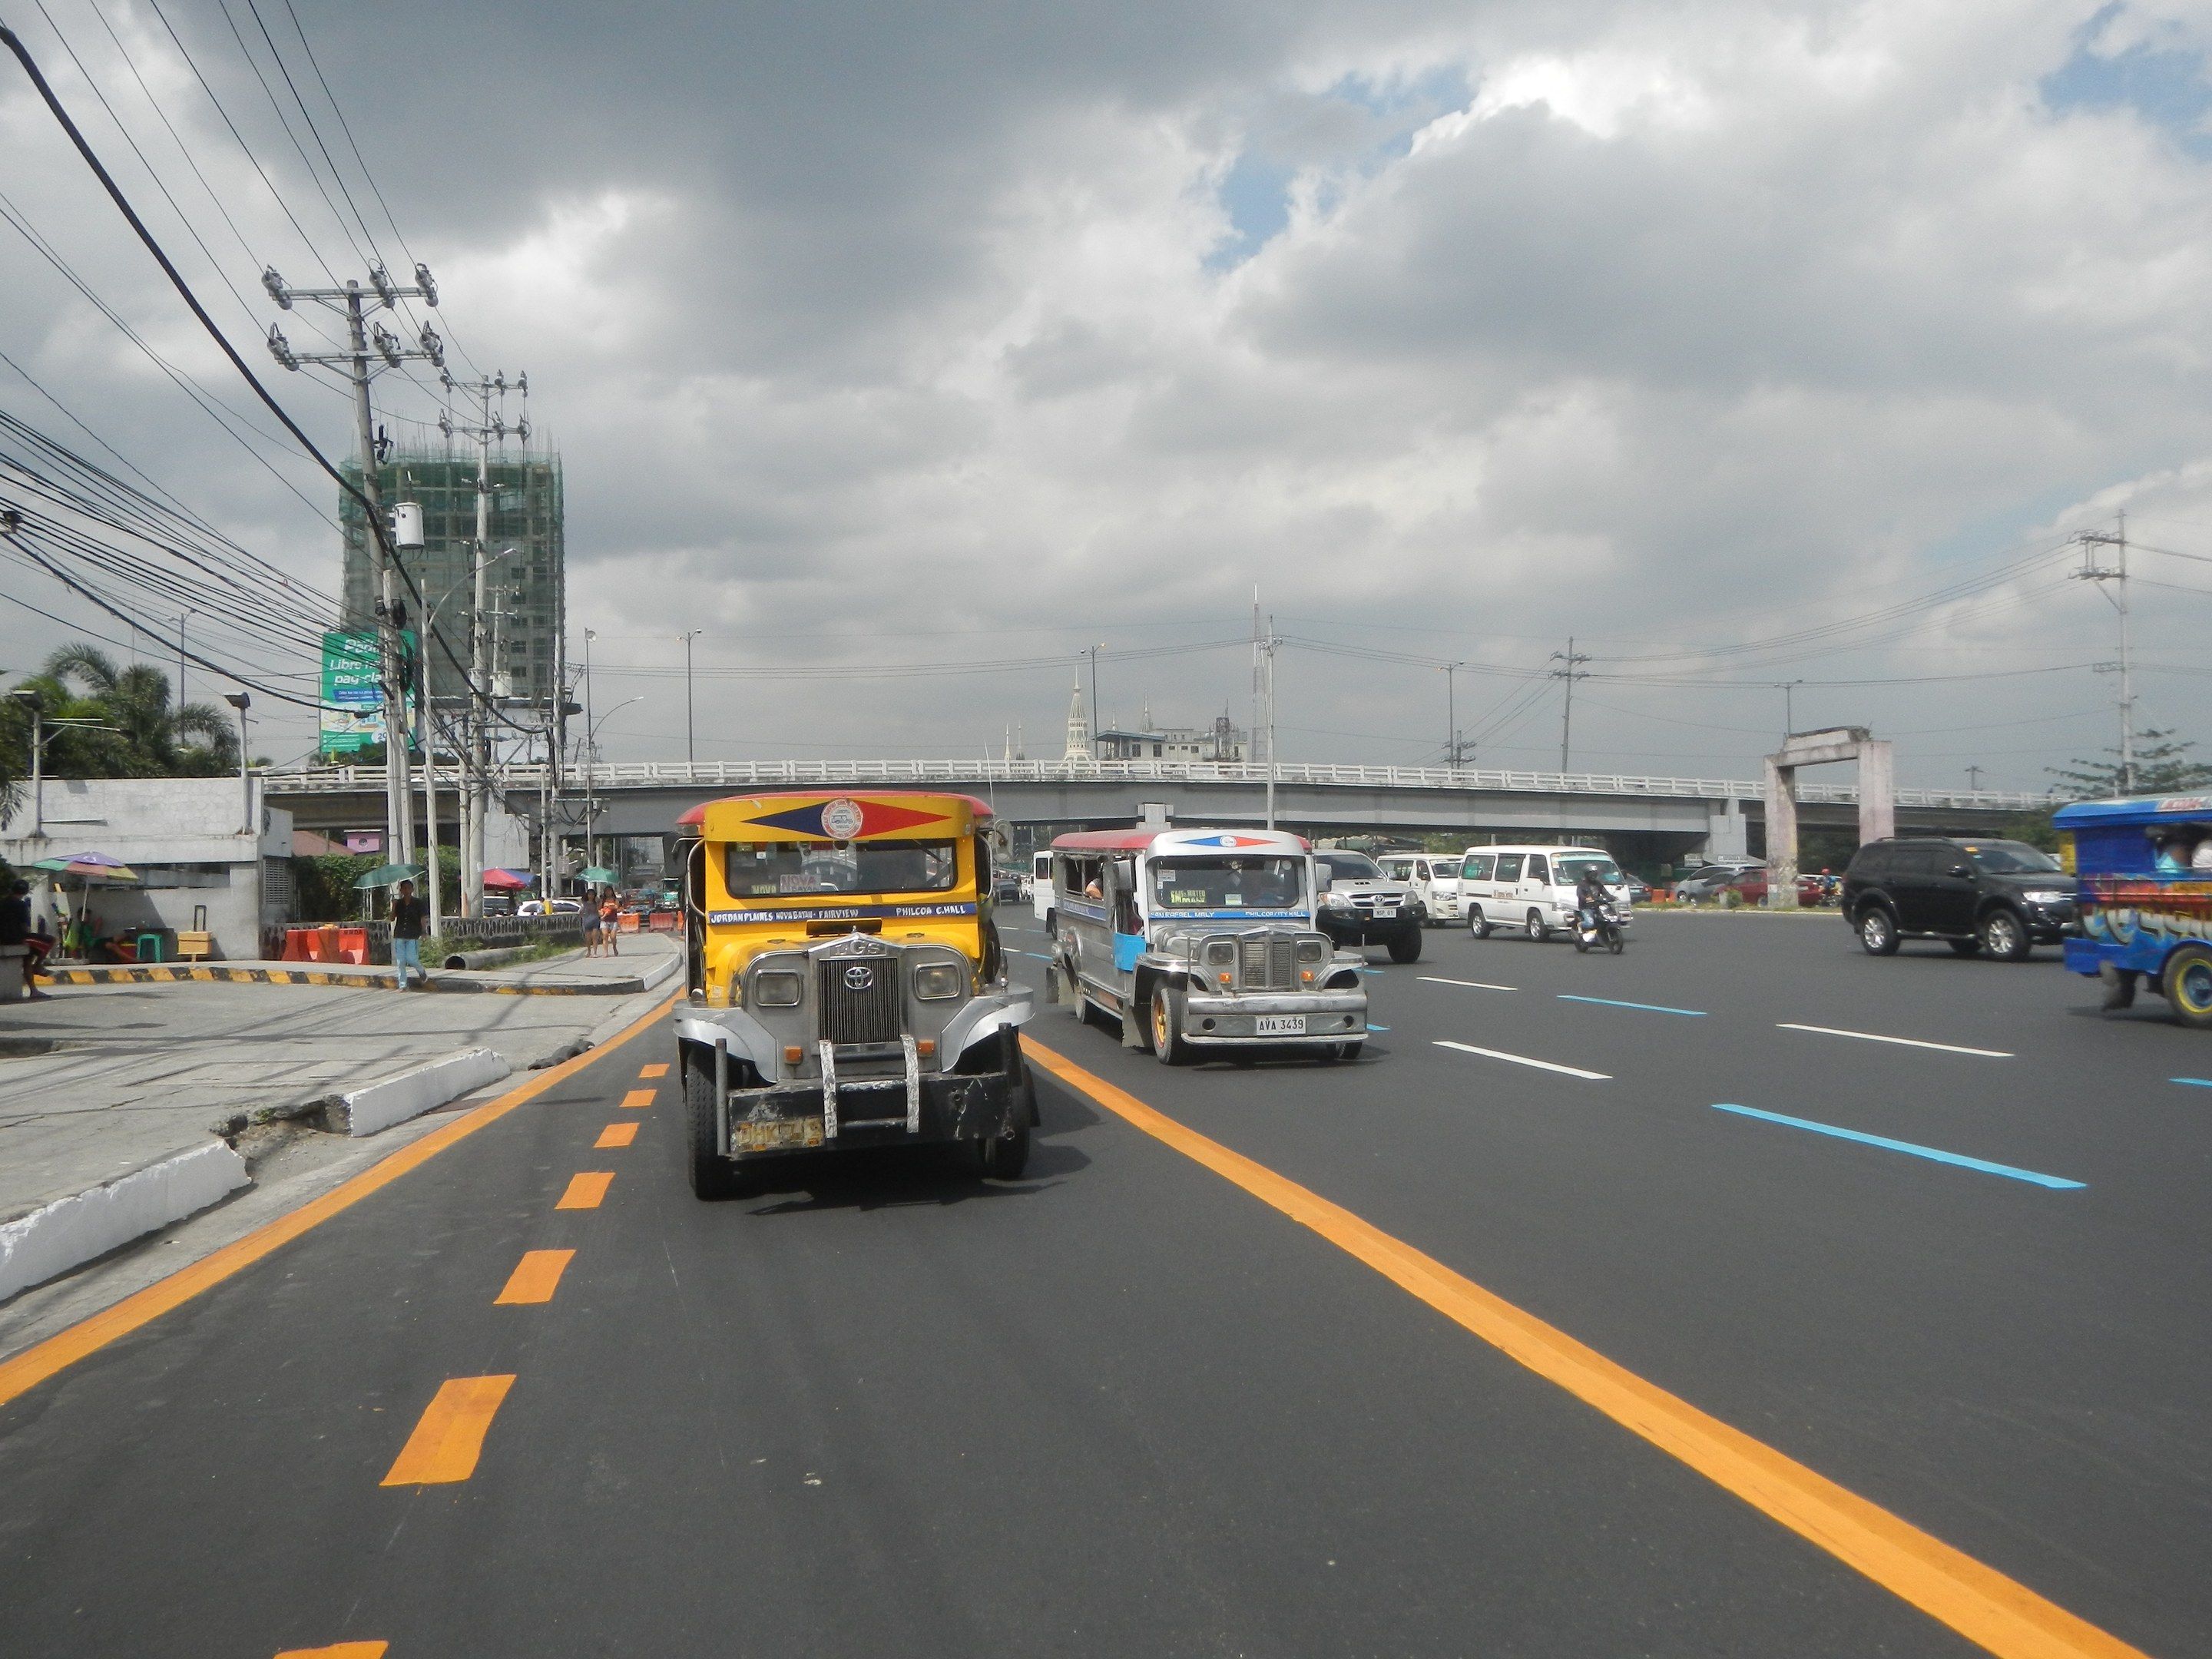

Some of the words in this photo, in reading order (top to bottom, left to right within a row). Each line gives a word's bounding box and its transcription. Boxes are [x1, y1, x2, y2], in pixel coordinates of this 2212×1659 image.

[329, 659, 362, 670] Libre
[819, 909, 859, 919] FAIRVIEW
[896, 906, 932, 916] PHILCOA
[1260, 1019, 1277, 1031] AVA
[1280, 1018, 1303, 1030] 3439
